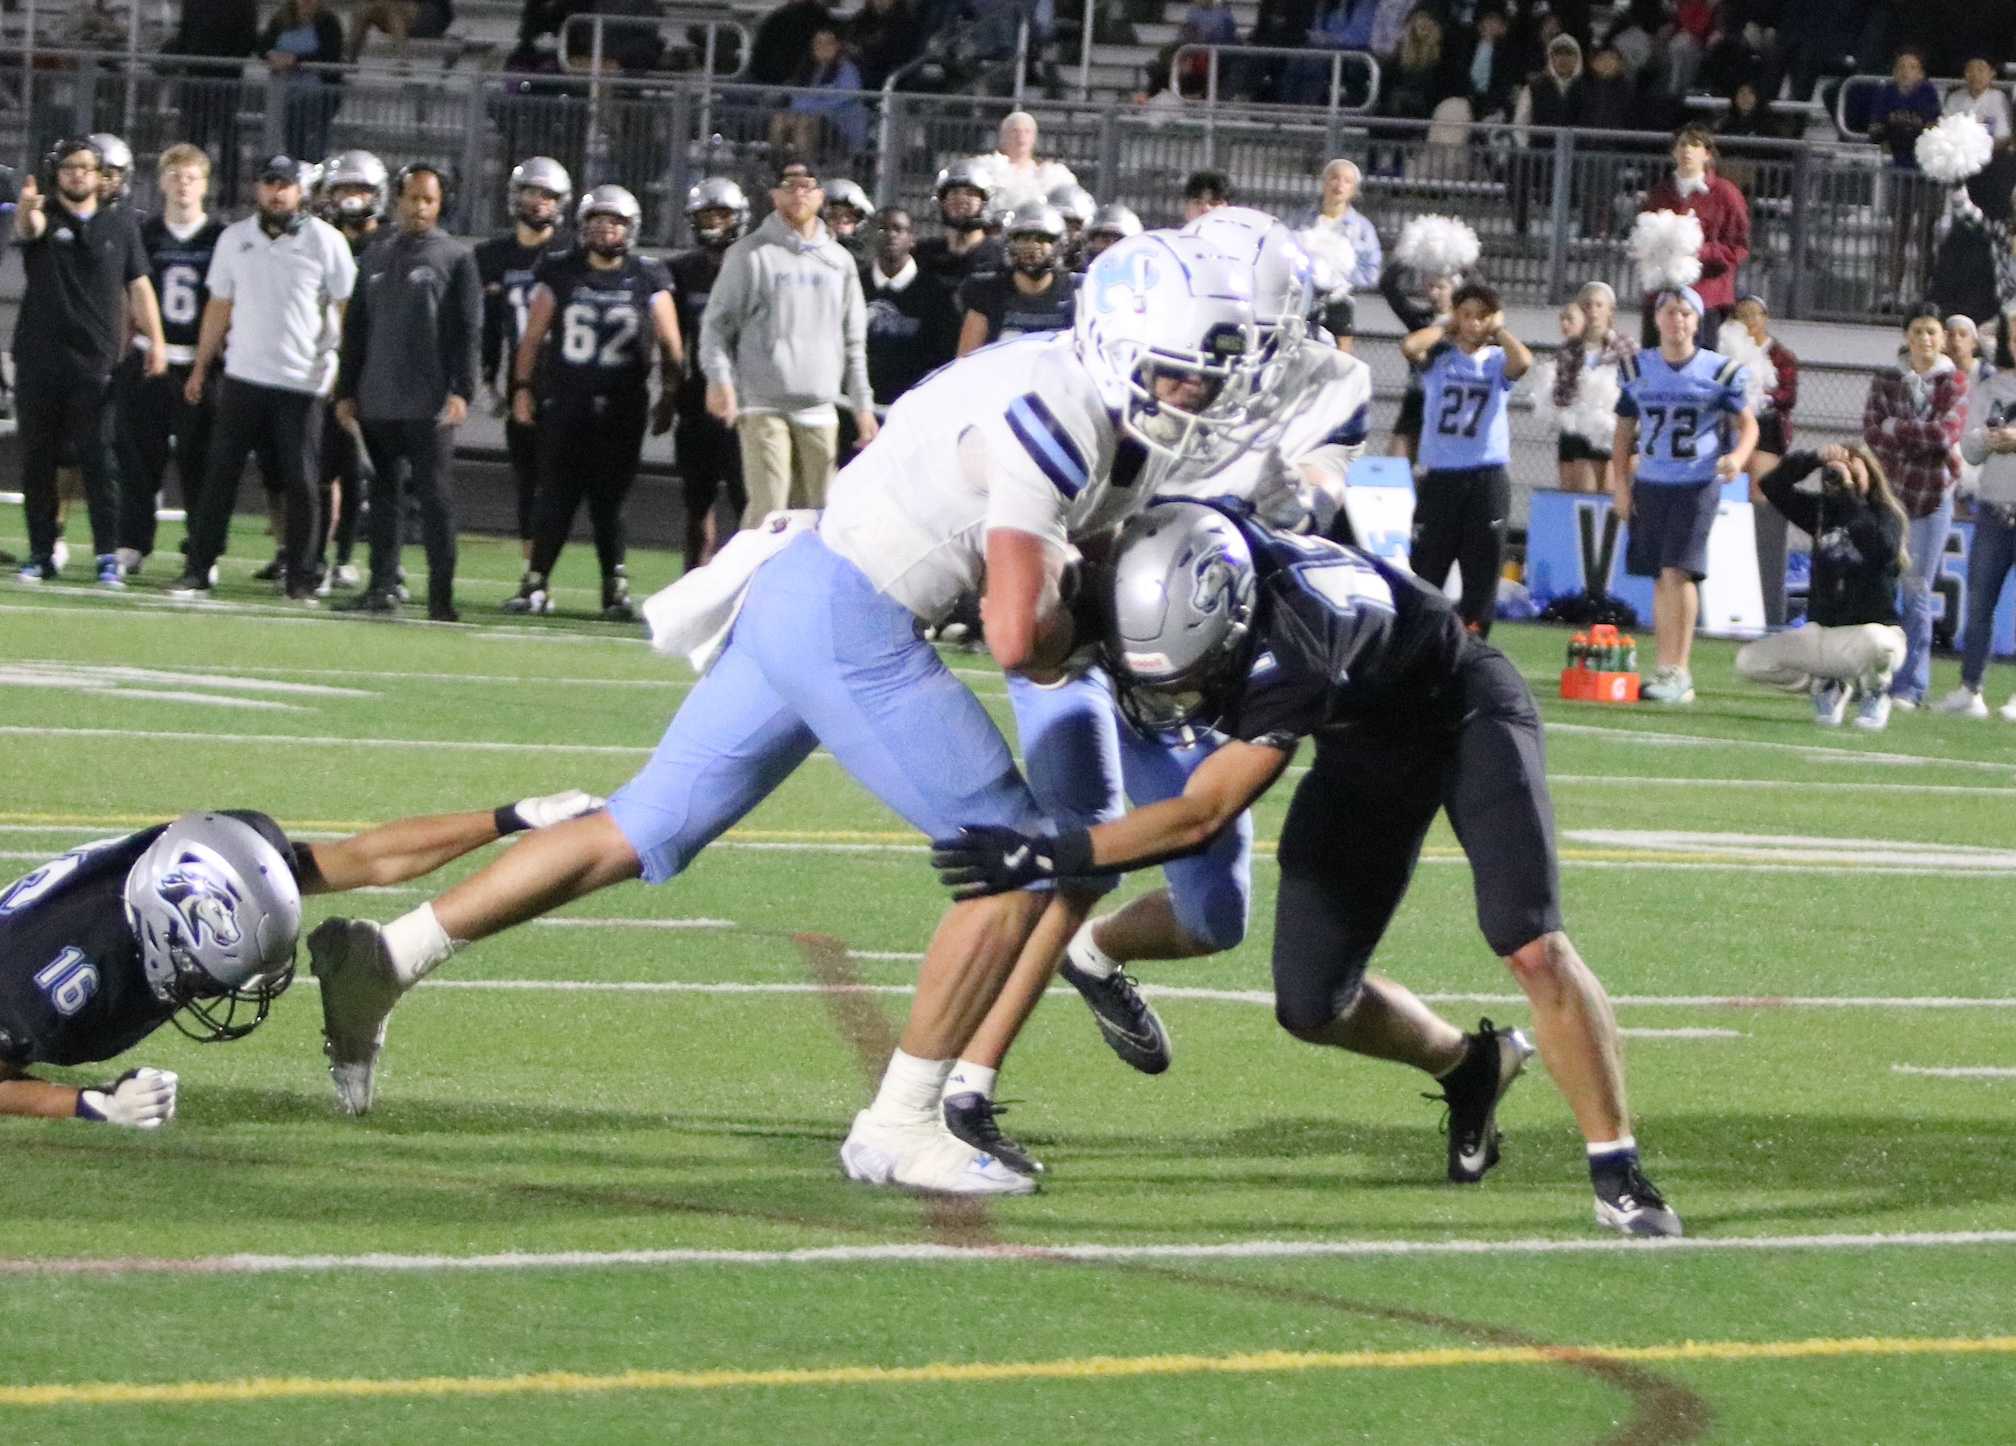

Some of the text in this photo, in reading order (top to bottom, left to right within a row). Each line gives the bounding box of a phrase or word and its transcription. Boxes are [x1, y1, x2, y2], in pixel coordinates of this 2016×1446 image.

[162, 265, 199, 323] 6
[562, 303, 639, 366] 62
[1438, 385, 1489, 438] 27
[1644, 405, 1699, 459] 72
[1575, 499, 1622, 600] V
[33, 945, 99, 1016] 16
